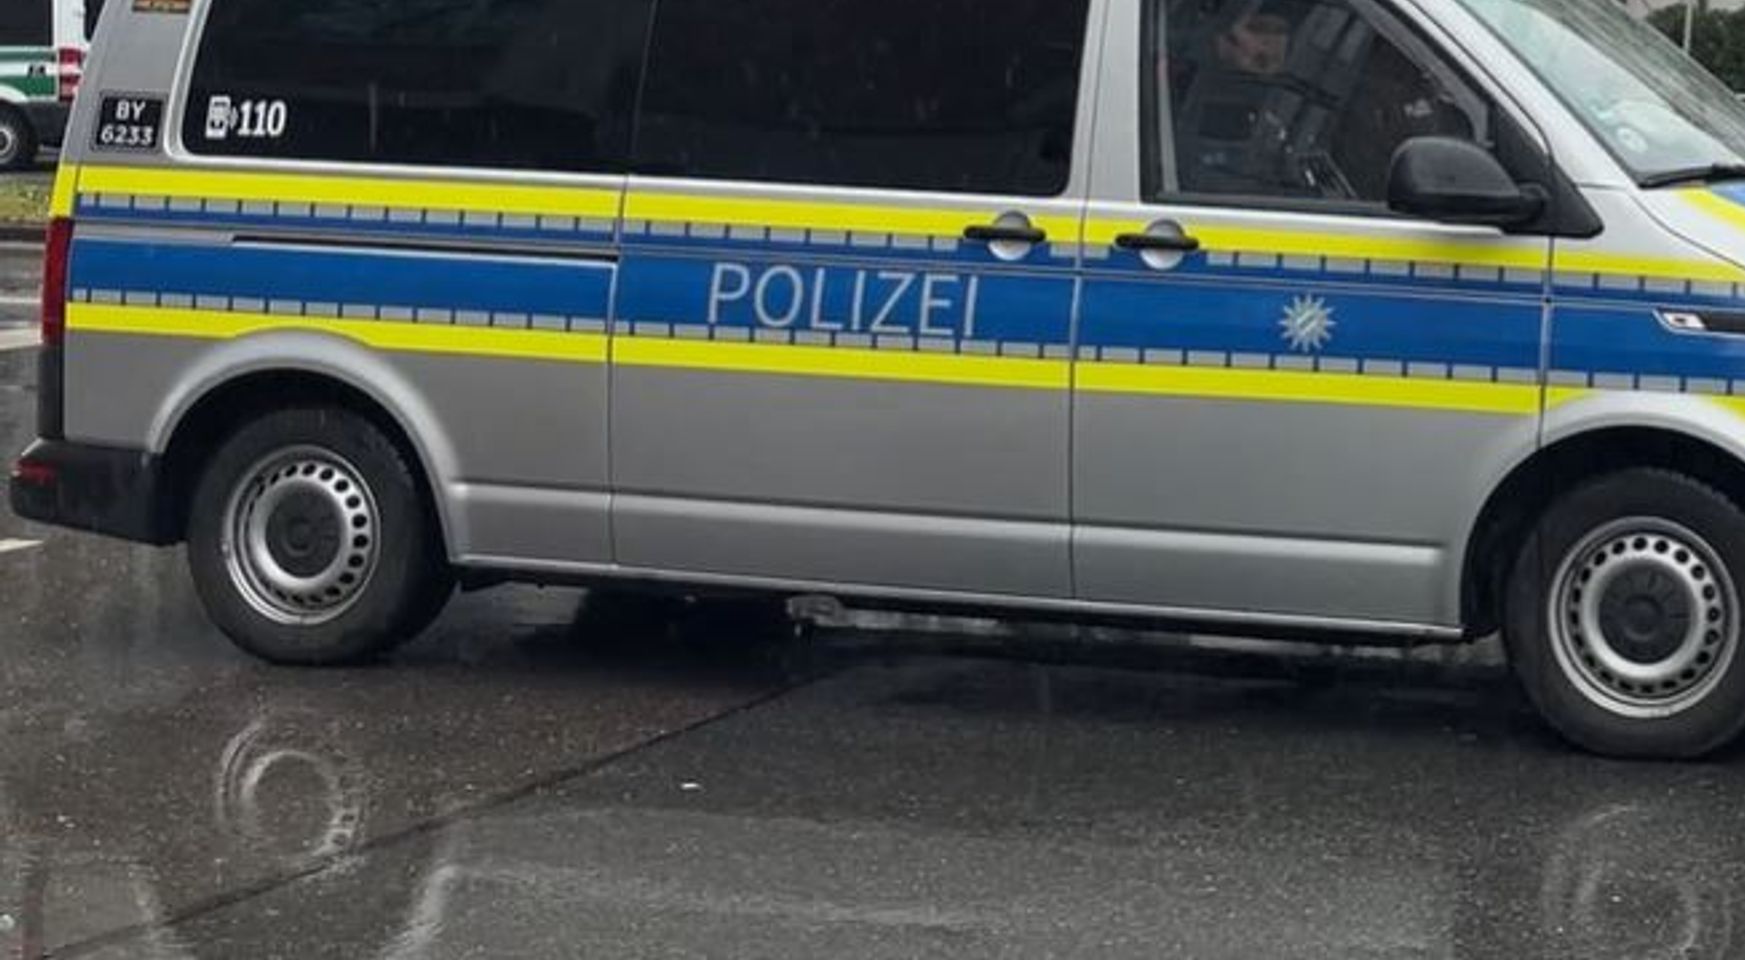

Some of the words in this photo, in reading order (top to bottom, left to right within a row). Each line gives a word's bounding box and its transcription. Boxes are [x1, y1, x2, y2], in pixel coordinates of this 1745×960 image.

[115, 100, 146, 120] BY
[236, 100, 288, 137] 110
[100, 125, 153, 145] 6233
[707, 261, 979, 337] POLIZEI
